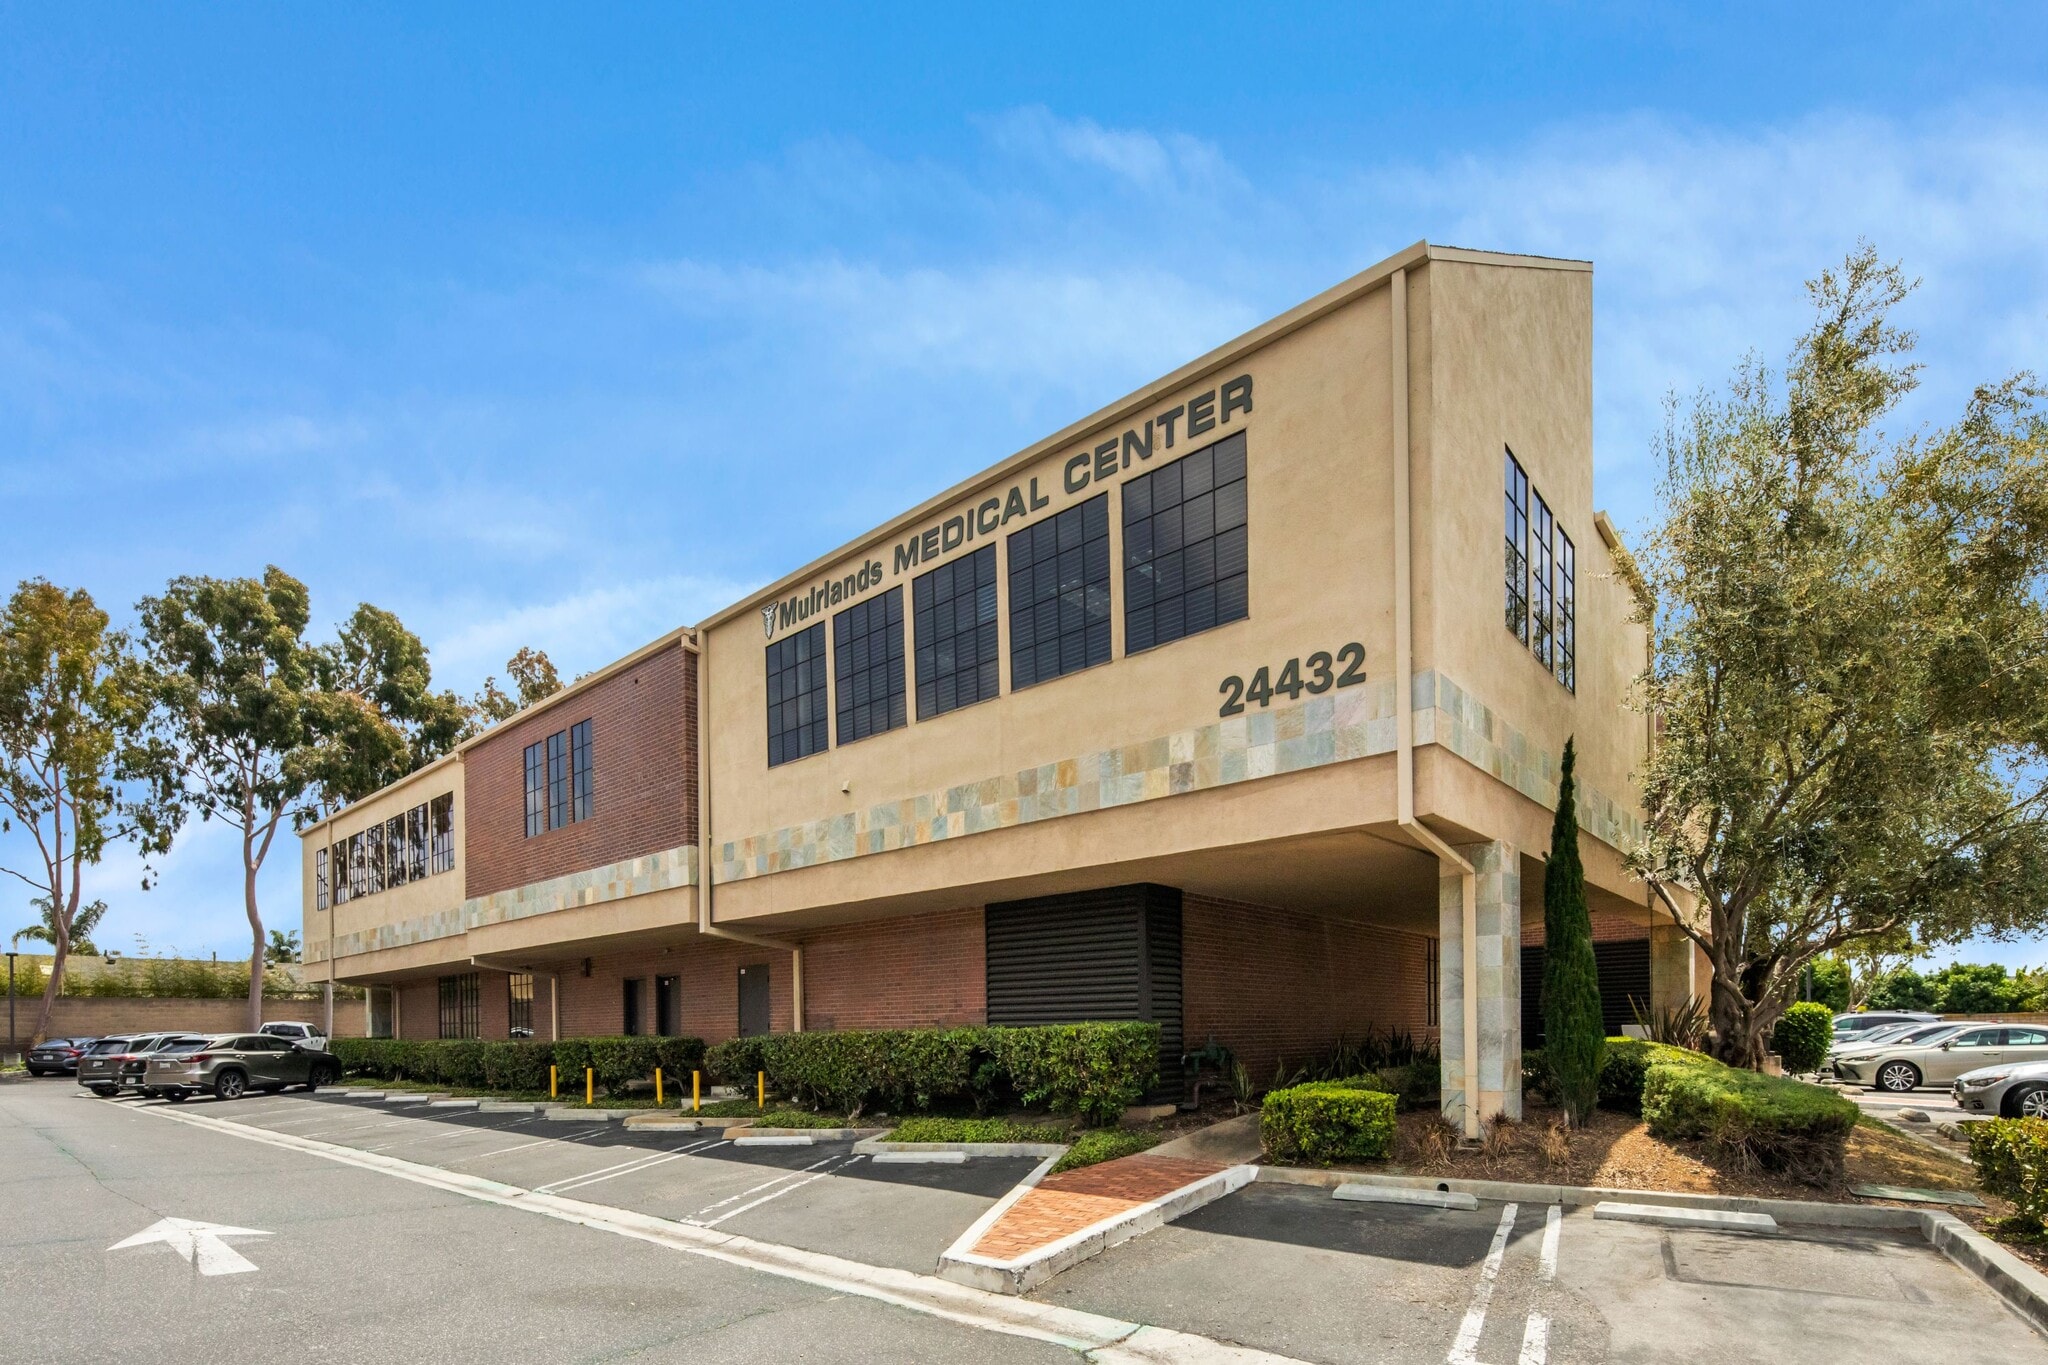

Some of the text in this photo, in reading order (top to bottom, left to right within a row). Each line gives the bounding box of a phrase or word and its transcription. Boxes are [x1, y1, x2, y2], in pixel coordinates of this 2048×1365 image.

[780, 374, 1253, 630] Muirlands MEDICAL CENTER
[1219, 642, 1367, 717] 24432
